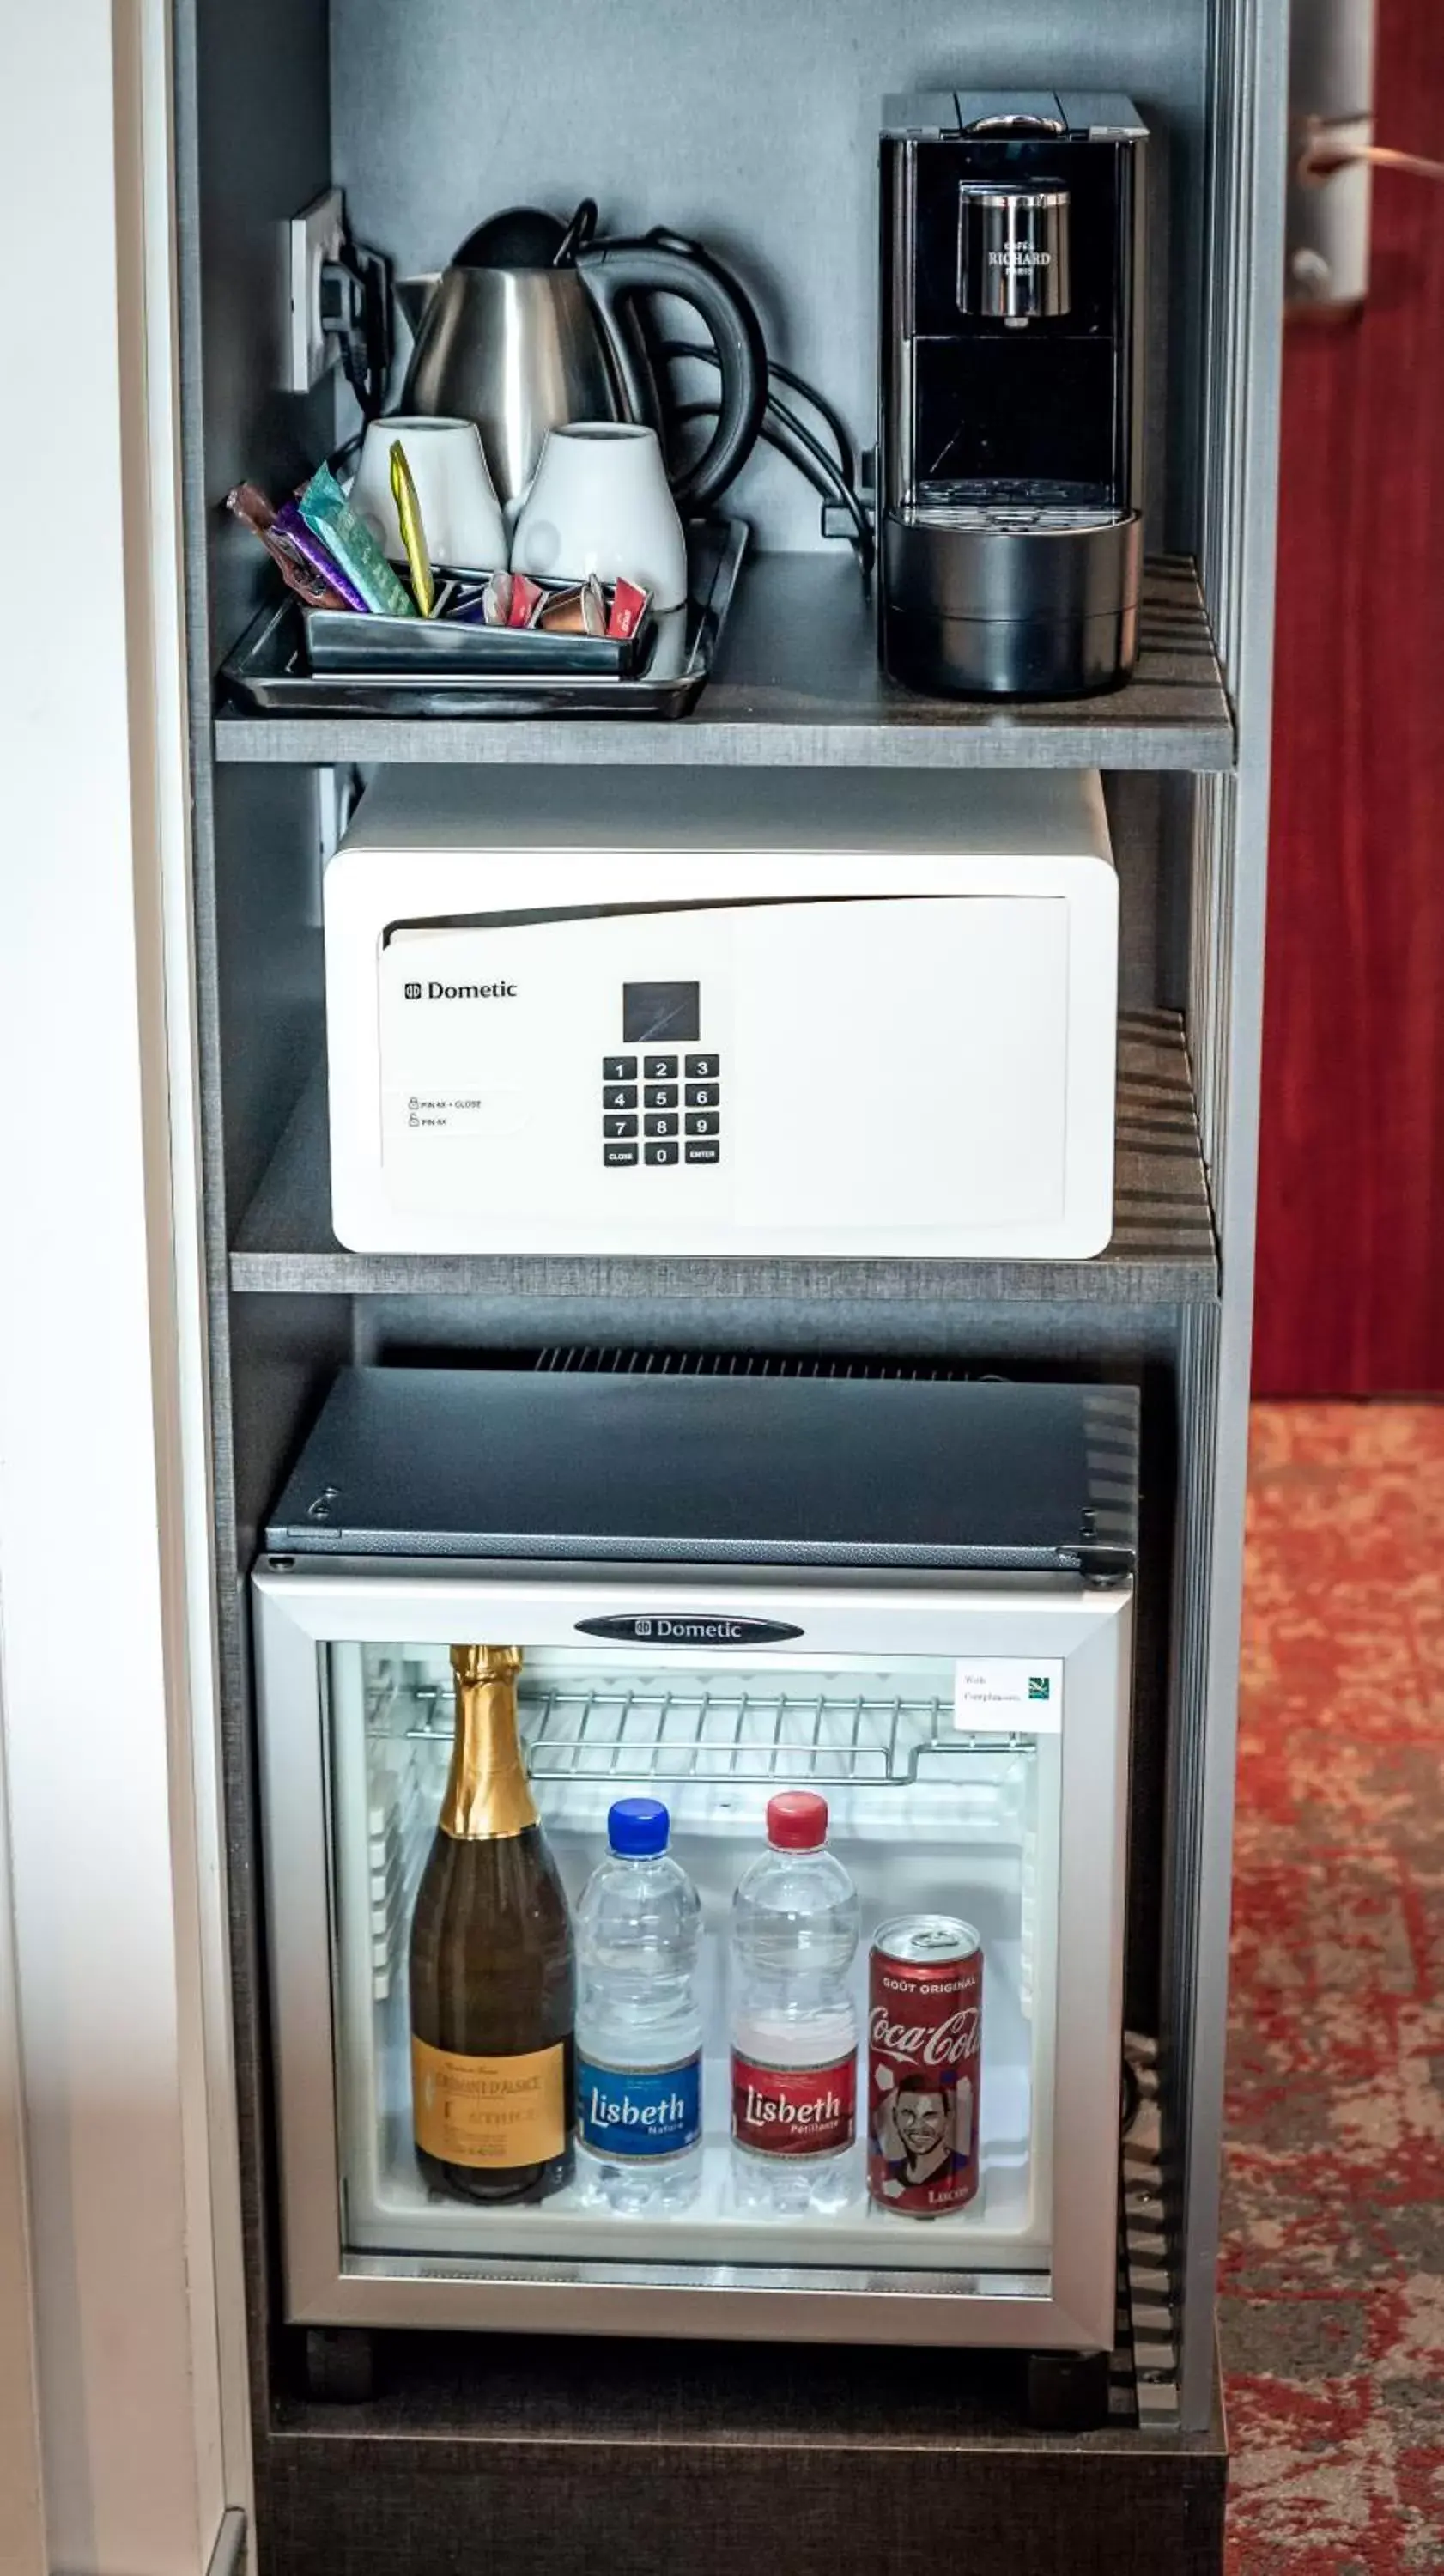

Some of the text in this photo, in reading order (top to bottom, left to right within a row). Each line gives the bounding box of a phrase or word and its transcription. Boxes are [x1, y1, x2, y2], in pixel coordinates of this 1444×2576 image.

[988, 252, 1051, 265] RICHARD
[428, 981, 517, 999] Dometic
[616, 1061, 708, 1078] 1 2 3
[455, 1100, 481, 1109] CLOSE
[615, 1091, 708, 1106] 4 5 6
[615, 1120, 708, 1135] 7 8 9
[656, 1150, 667, 1162] 0
[657, 1620, 743, 1637] Dometic
[964, 1692, 1021, 1702] Compli
[883, 1977, 976, 1994] GOÛT ORIGINAL
[590, 2086, 685, 2128] Lisbeth
[746, 2084, 840, 2126] Lisbeth
